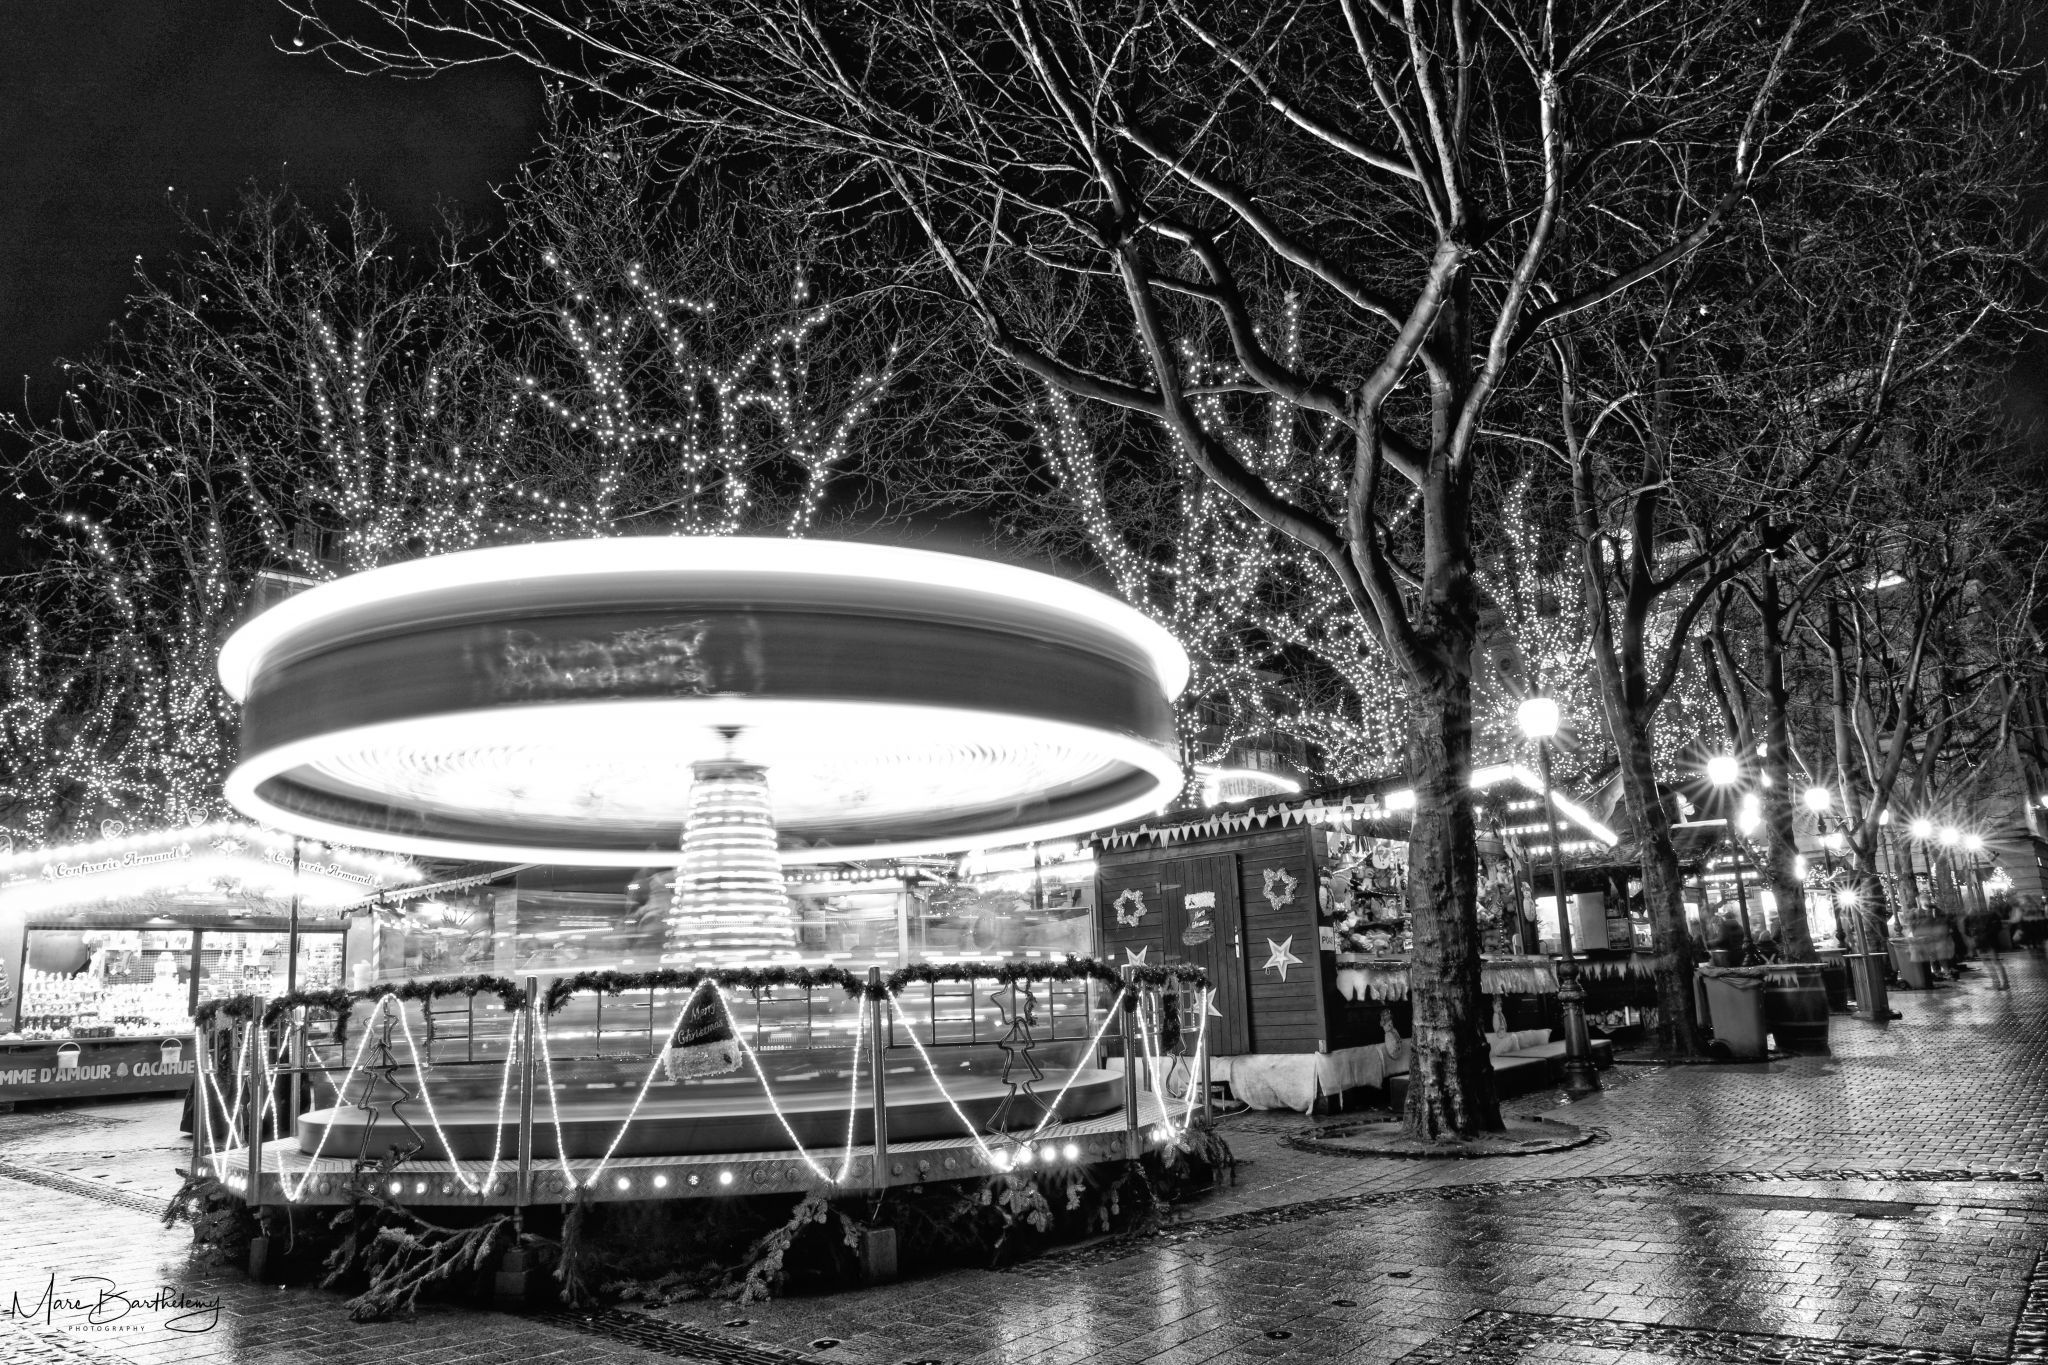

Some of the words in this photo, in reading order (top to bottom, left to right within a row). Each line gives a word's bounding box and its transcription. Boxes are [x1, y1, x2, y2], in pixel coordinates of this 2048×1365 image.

[55, 859, 119, 878] Confiserie
[122, 847, 178, 867] Armand
[273, 851, 324, 874] Conserie
[326, 863, 374, 886] Armand
[40, 1064, 111, 1083] D'AMOUR
